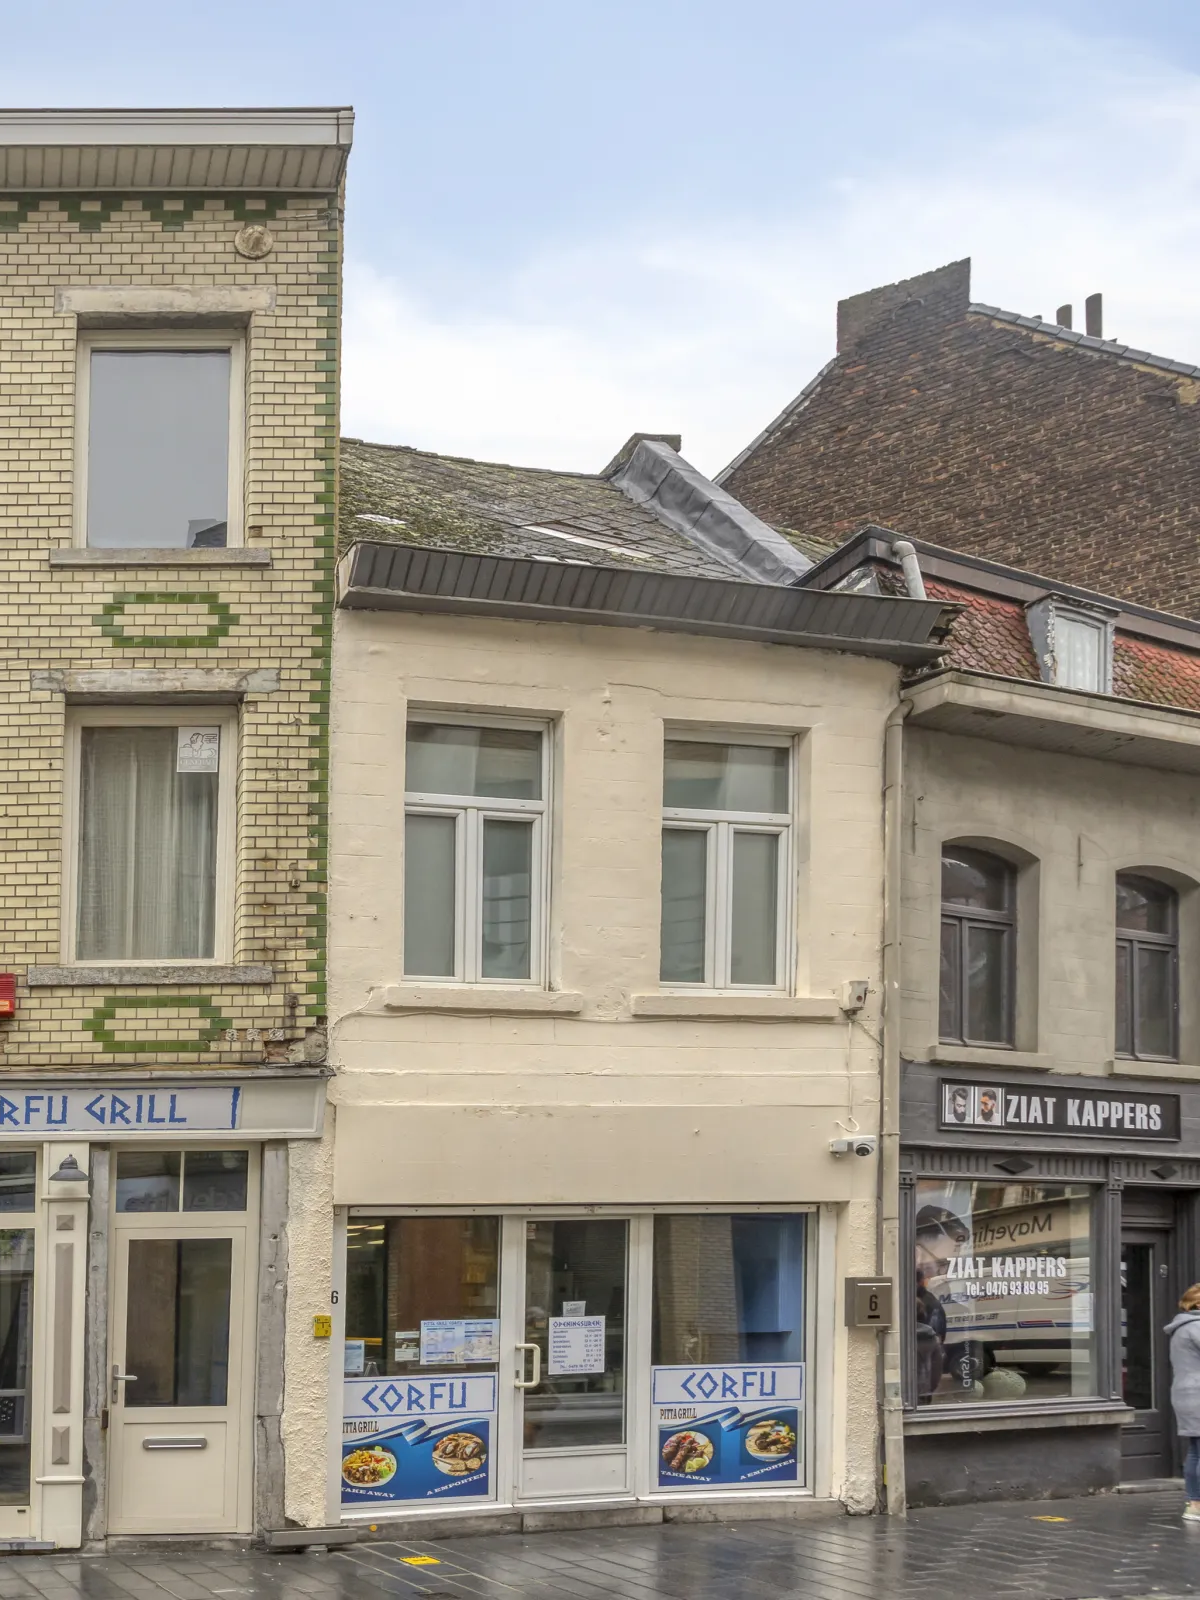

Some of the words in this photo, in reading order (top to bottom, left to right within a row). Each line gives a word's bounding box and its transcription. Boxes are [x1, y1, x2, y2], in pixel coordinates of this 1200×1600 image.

[84, 1093, 187, 1125] GRILL
[1006, 1094, 1057, 1125] ZIAT
[1066, 1098, 1162, 1131] KAPPERS
[946, 1257, 986, 1279] ZIAT
[992, 1257, 1067, 1278] KAPPERS
[330, 1290, 339, 1304] 6
[986, 1281, 1008, 1295] 0476
[1009, 1281, 1023, 1295] 93
[1023, 1281, 1036, 1295] 89
[1036, 1280, 1049, 1294] 95
[869, 1294, 878, 1312] 6
[680, 1371, 776, 1399] CORFU
[361, 1381, 467, 1413] CORFU
[660, 1408, 677, 1420] PITTA
[677, 1407, 697, 1419] GRILL
[342, 1422, 357, 1434] ITTA
[357, 1421, 379, 1433] GRILL
[746, 1459, 796, 1478] EMPORTER
[434, 1472, 487, 1493] EMPORTER
